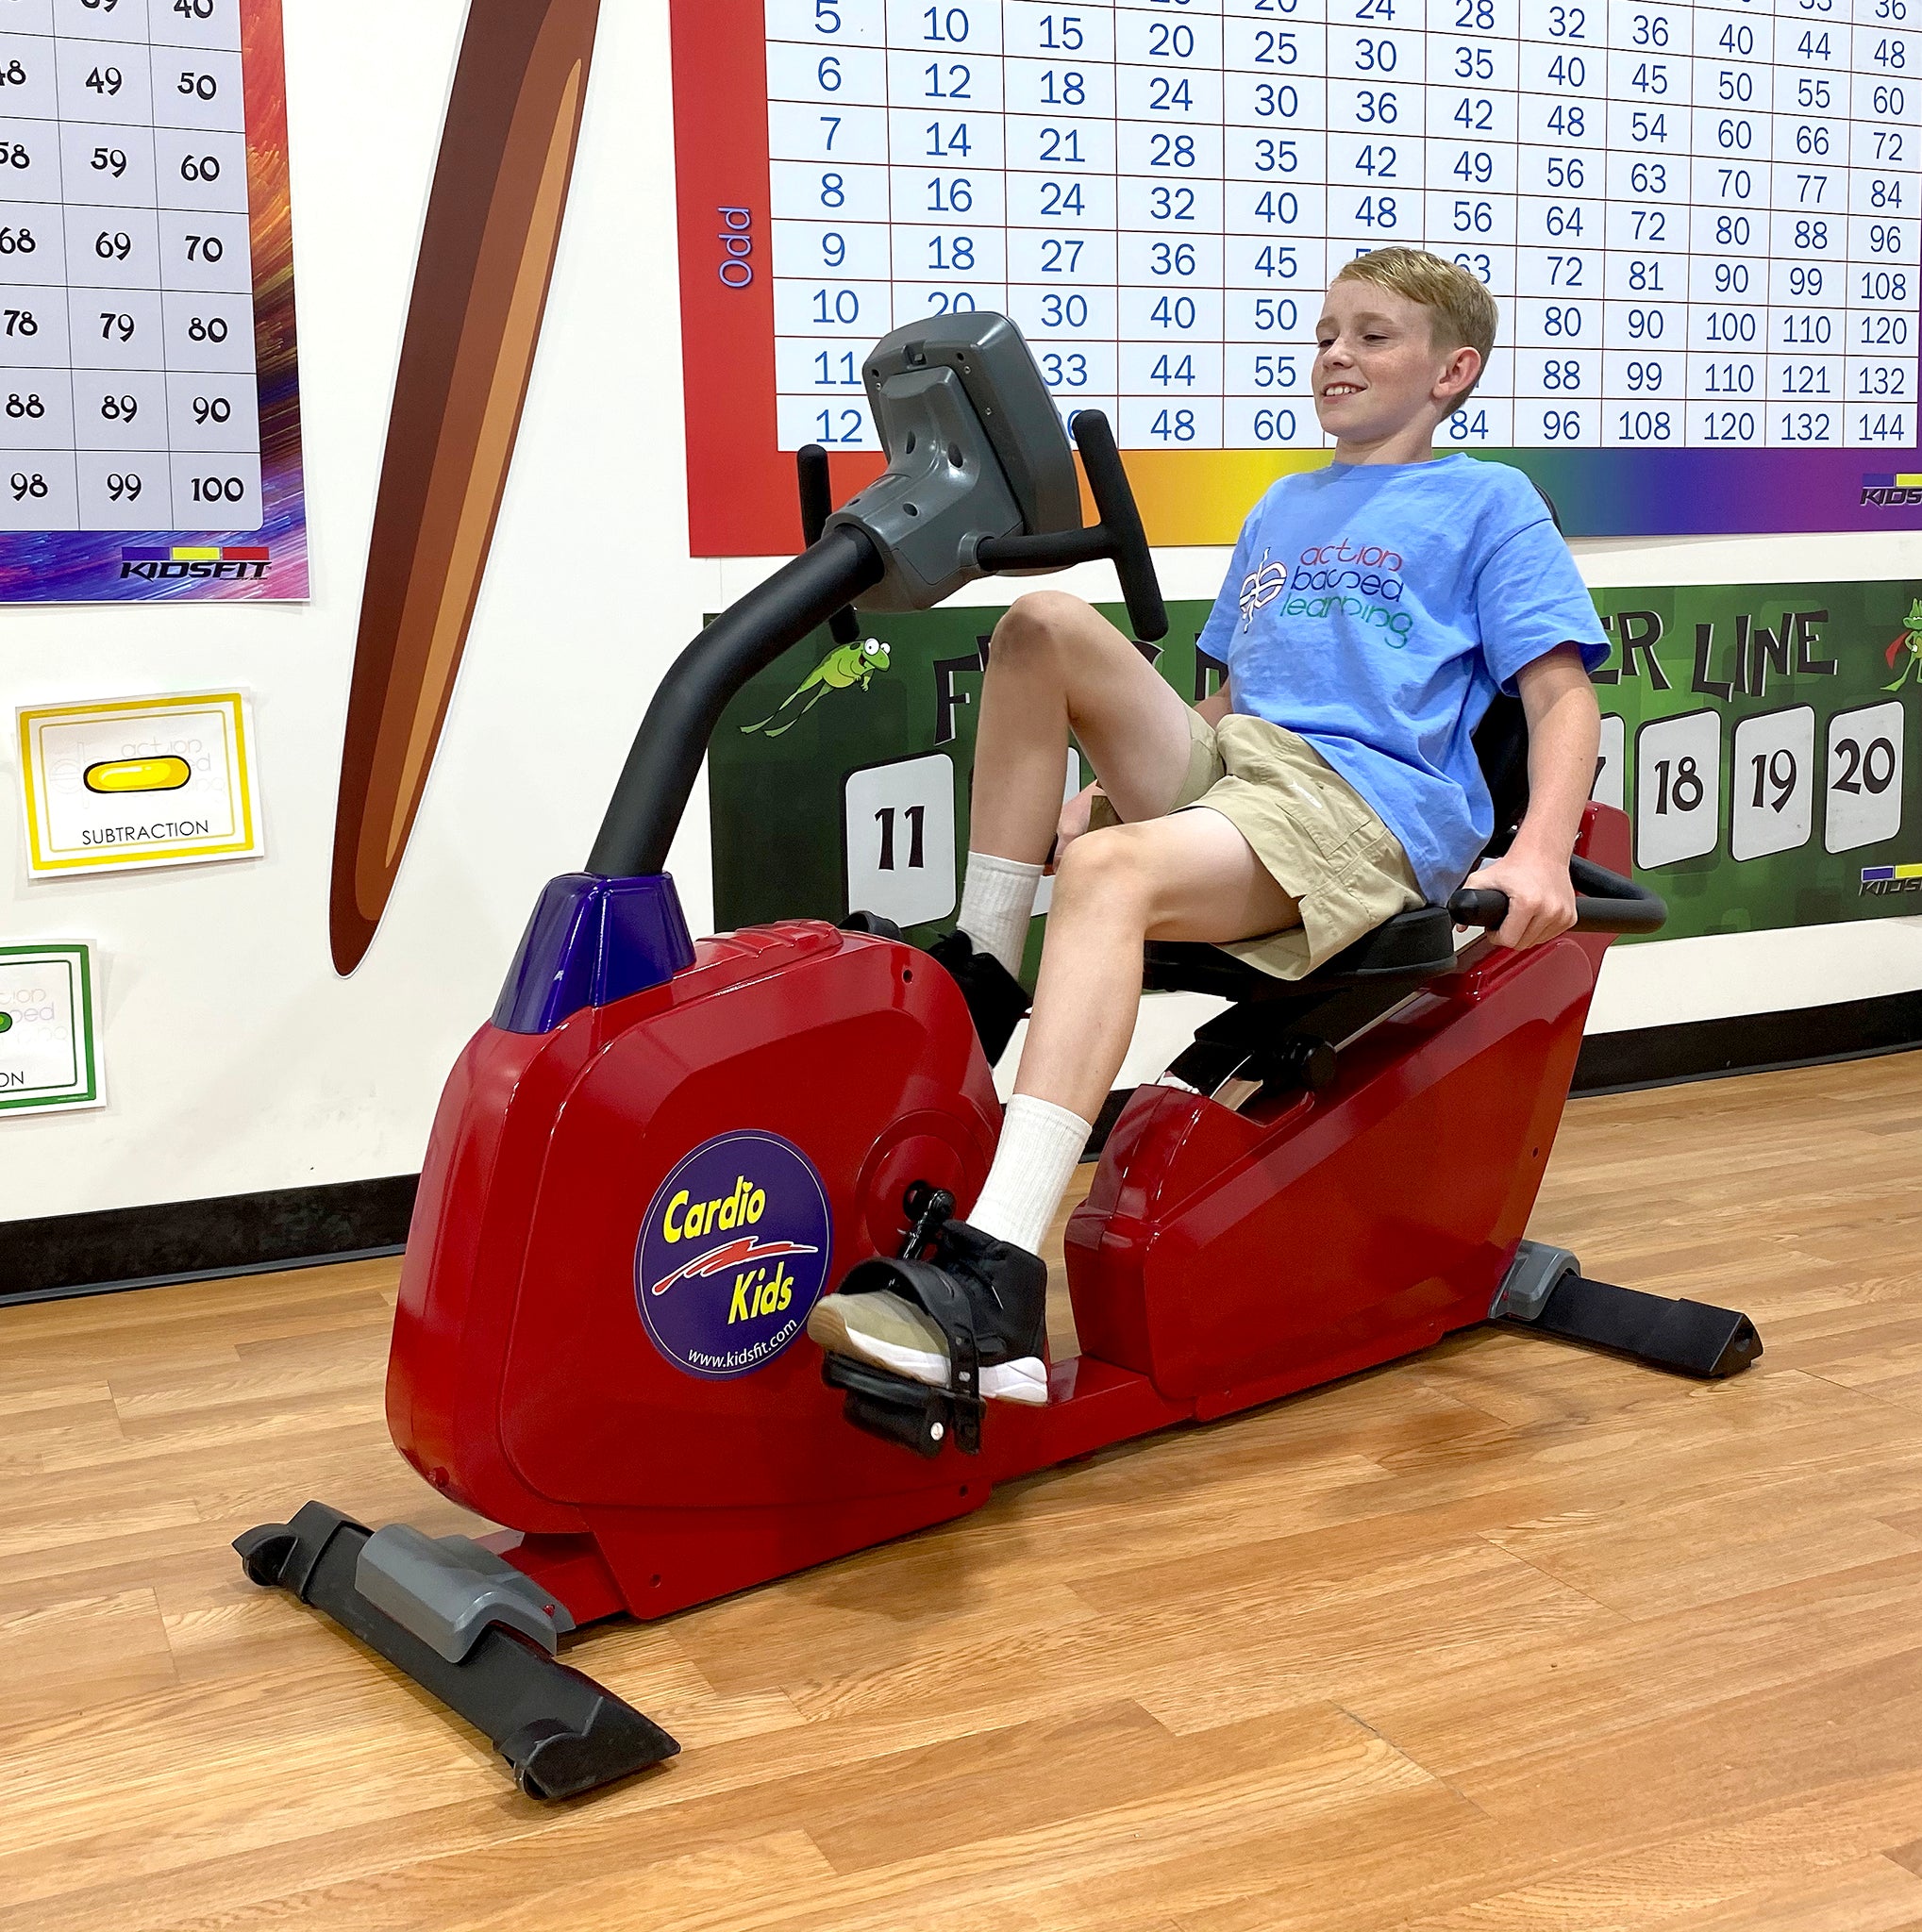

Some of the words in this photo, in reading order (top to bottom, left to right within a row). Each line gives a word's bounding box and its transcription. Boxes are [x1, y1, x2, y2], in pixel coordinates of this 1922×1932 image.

[173, 0, 214, 19] 40
[1355, 0, 1396, 21] 24
[1455, 0, 1495, 30] 28
[1549, 6, 1585, 39] 32
[1632, 14, 1668, 45] 36
[1718, 24, 1754, 56] 40
[1797, 30, 1831, 61] 44
[1873, 39, 1906, 69] 48
[85, 66, 123, 96] 49
[176, 72, 217, 101] 50
[814, 0, 842, 34] 5
[923, 6, 969, 42] 10
[1040, 14, 1084, 51] 15
[1148, 23, 1195, 58] 20
[1254, 30, 1297, 65] 25
[1355, 38, 1397, 73] 30
[1454, 46, 1494, 80] 35
[1547, 55, 1585, 88] 40
[1631, 62, 1667, 95] 45
[1718, 70, 1753, 102] 50
[1797, 77, 1830, 109] 55
[1873, 85, 1905, 116] 60
[817, 56, 842, 92] 6
[925, 62, 972, 99] 12
[1041, 70, 1086, 106] 18
[1149, 76, 1194, 110] 24
[1254, 83, 1298, 118] 30
[1355, 90, 1397, 125] 36
[1453, 97, 1493, 130] 42
[1546, 105, 1585, 138] 48
[1631, 111, 1668, 143] 54
[1717, 118, 1752, 150] 60
[1796, 125, 1830, 156] 66
[1873, 131, 1903, 161] 72
[90, 147, 127, 178] 59
[180, 154, 220, 182] 60
[820, 116, 842, 151] 7
[926, 122, 972, 158] 14
[1039, 127, 1086, 163] 21
[1150, 133, 1195, 168] 28
[1254, 139, 1298, 173] 35
[1355, 144, 1396, 177] 42
[1453, 150, 1493, 183] 49
[1546, 157, 1584, 189] 56
[1630, 162, 1666, 194] 63
[1717, 168, 1751, 199] 70
[1797, 174, 1828, 204] 77
[1870, 179, 1903, 209] 84
[820, 173, 845, 208] 8
[927, 176, 973, 213] 16
[1040, 181, 1086, 216] 24
[1150, 186, 1195, 221] 32
[1254, 191, 1298, 225] 40
[1355, 195, 1397, 228] 48
[1454, 200, 1493, 233] 56
[1546, 206, 1583, 237] 64
[1631, 210, 1665, 242] 72
[1715, 215, 1750, 246] 80
[1794, 220, 1828, 250] 88
[1870, 225, 1901, 254] 96
[0, 226, 36, 255] 68
[95, 231, 131, 261] 69
[184, 235, 224, 263] 70
[717, 207, 753, 288] Odd
[822, 232, 845, 267] 9
[928, 235, 975, 271] 18
[1041, 239, 1084, 273] 27
[1150, 242, 1195, 276] 36
[1254, 245, 1297, 279] 45
[1548, 256, 1583, 287] 72
[1629, 260, 1663, 291] 81
[1714, 263, 1749, 293] 90
[1789, 266, 1823, 296] 99
[1861, 272, 1907, 301] 108
[3, 309, 38, 337] 78
[99, 312, 135, 342] 79
[188, 317, 228, 343] 80
[812, 289, 860, 325] 10
[1041, 293, 1088, 328] 30
[1150, 295, 1195, 329] 40
[1255, 298, 1297, 331] 50
[1544, 306, 1582, 338] 80
[1628, 308, 1665, 341] 90
[1706, 311, 1756, 342] 100
[1782, 314, 1831, 344] 110
[1861, 316, 1908, 345] 120
[814, 350, 862, 386] 11
[1042, 353, 1088, 389] 33
[1150, 354, 1196, 387] 44
[1254, 356, 1296, 388] 55
[1543, 359, 1581, 391] 88
[1627, 361, 1663, 391] 99
[1704, 363, 1754, 393] 110
[1781, 364, 1831, 393] 121
[1858, 366, 1905, 395] 132
[5, 393, 45, 419] 88
[101, 394, 138, 424] 89
[192, 396, 231, 425] 90
[816, 408, 863, 443] 12
[1150, 408, 1195, 441] 48
[1253, 408, 1296, 441] 60
[1449, 408, 1489, 441] 84
[1543, 410, 1580, 441] 96
[1618, 410, 1672, 441] 108
[1704, 411, 1755, 441] 120
[1780, 412, 1830, 441] 132
[1858, 413, 1905, 441] 144
[10, 473, 48, 502] 98
[107, 473, 142, 502] 99
[191, 476, 244, 503] 100
[1300, 538, 1402, 572] action
[1290, 566, 1404, 603] based
[1279, 592, 1413, 649] learning
[1691, 609, 1838, 702] LINE
[874, 805, 926, 872] 11
[1654, 756, 1704, 816] 18
[1751, 749, 1797, 813] 19
[1831, 737, 1896, 795] 20
[82, 820, 209, 845] SUBTRACTION
[662, 1175, 766, 1243] Cardio
[727, 1261, 794, 1324] Kids
[688, 1319, 797, 1368] www.kidsfit.com
